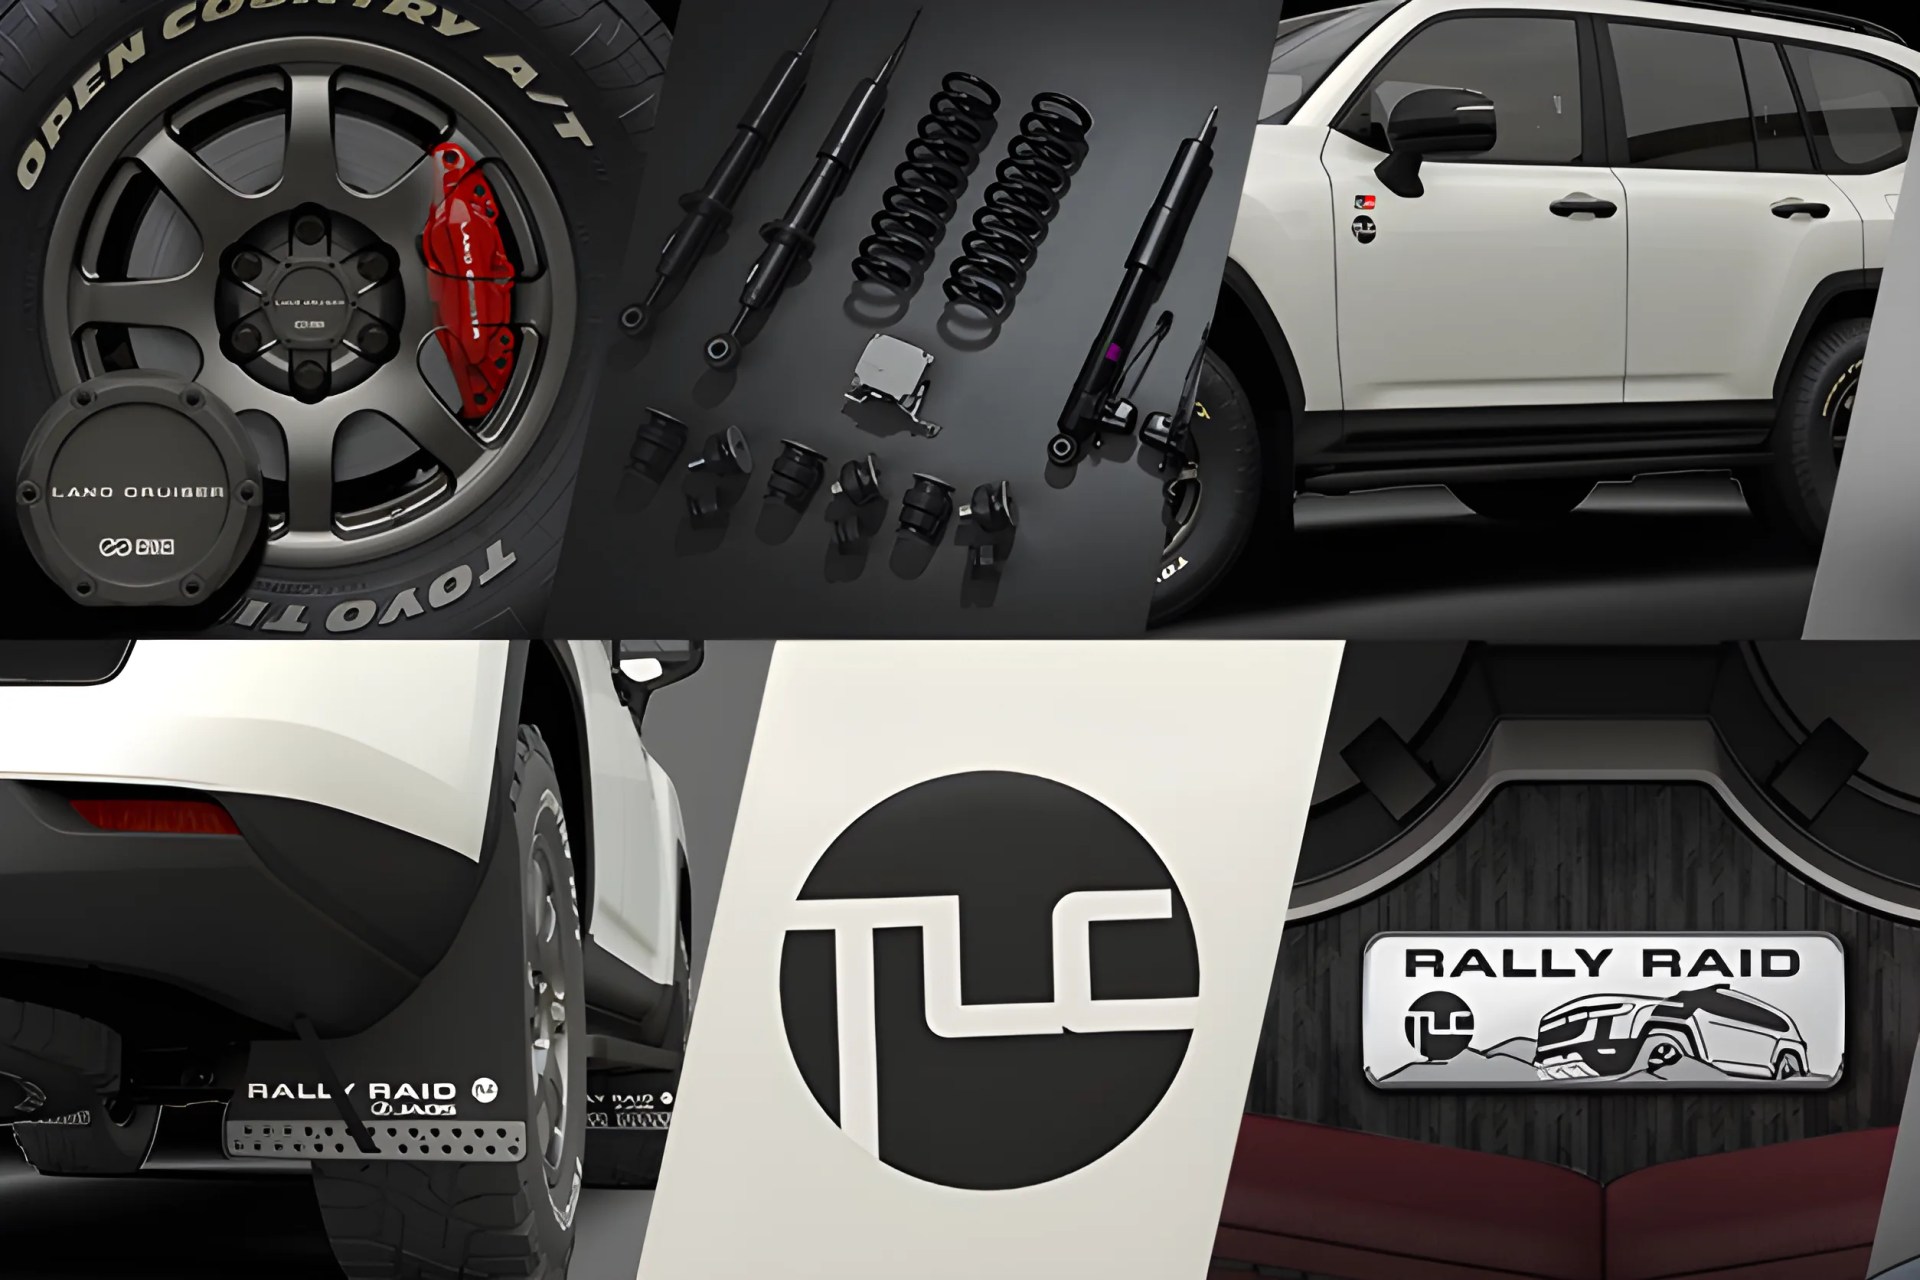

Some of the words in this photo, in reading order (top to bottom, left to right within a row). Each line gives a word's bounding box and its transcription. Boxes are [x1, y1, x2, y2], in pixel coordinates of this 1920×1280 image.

[16, 29, 146, 190] OPEN
[483, 54, 594, 147] A/T
[325, 539, 517, 632] TOYO
[1405, 948, 1614, 978] RALLY
[1642, 948, 1801, 978] RAID
[369, 1082, 457, 1100] RAID
